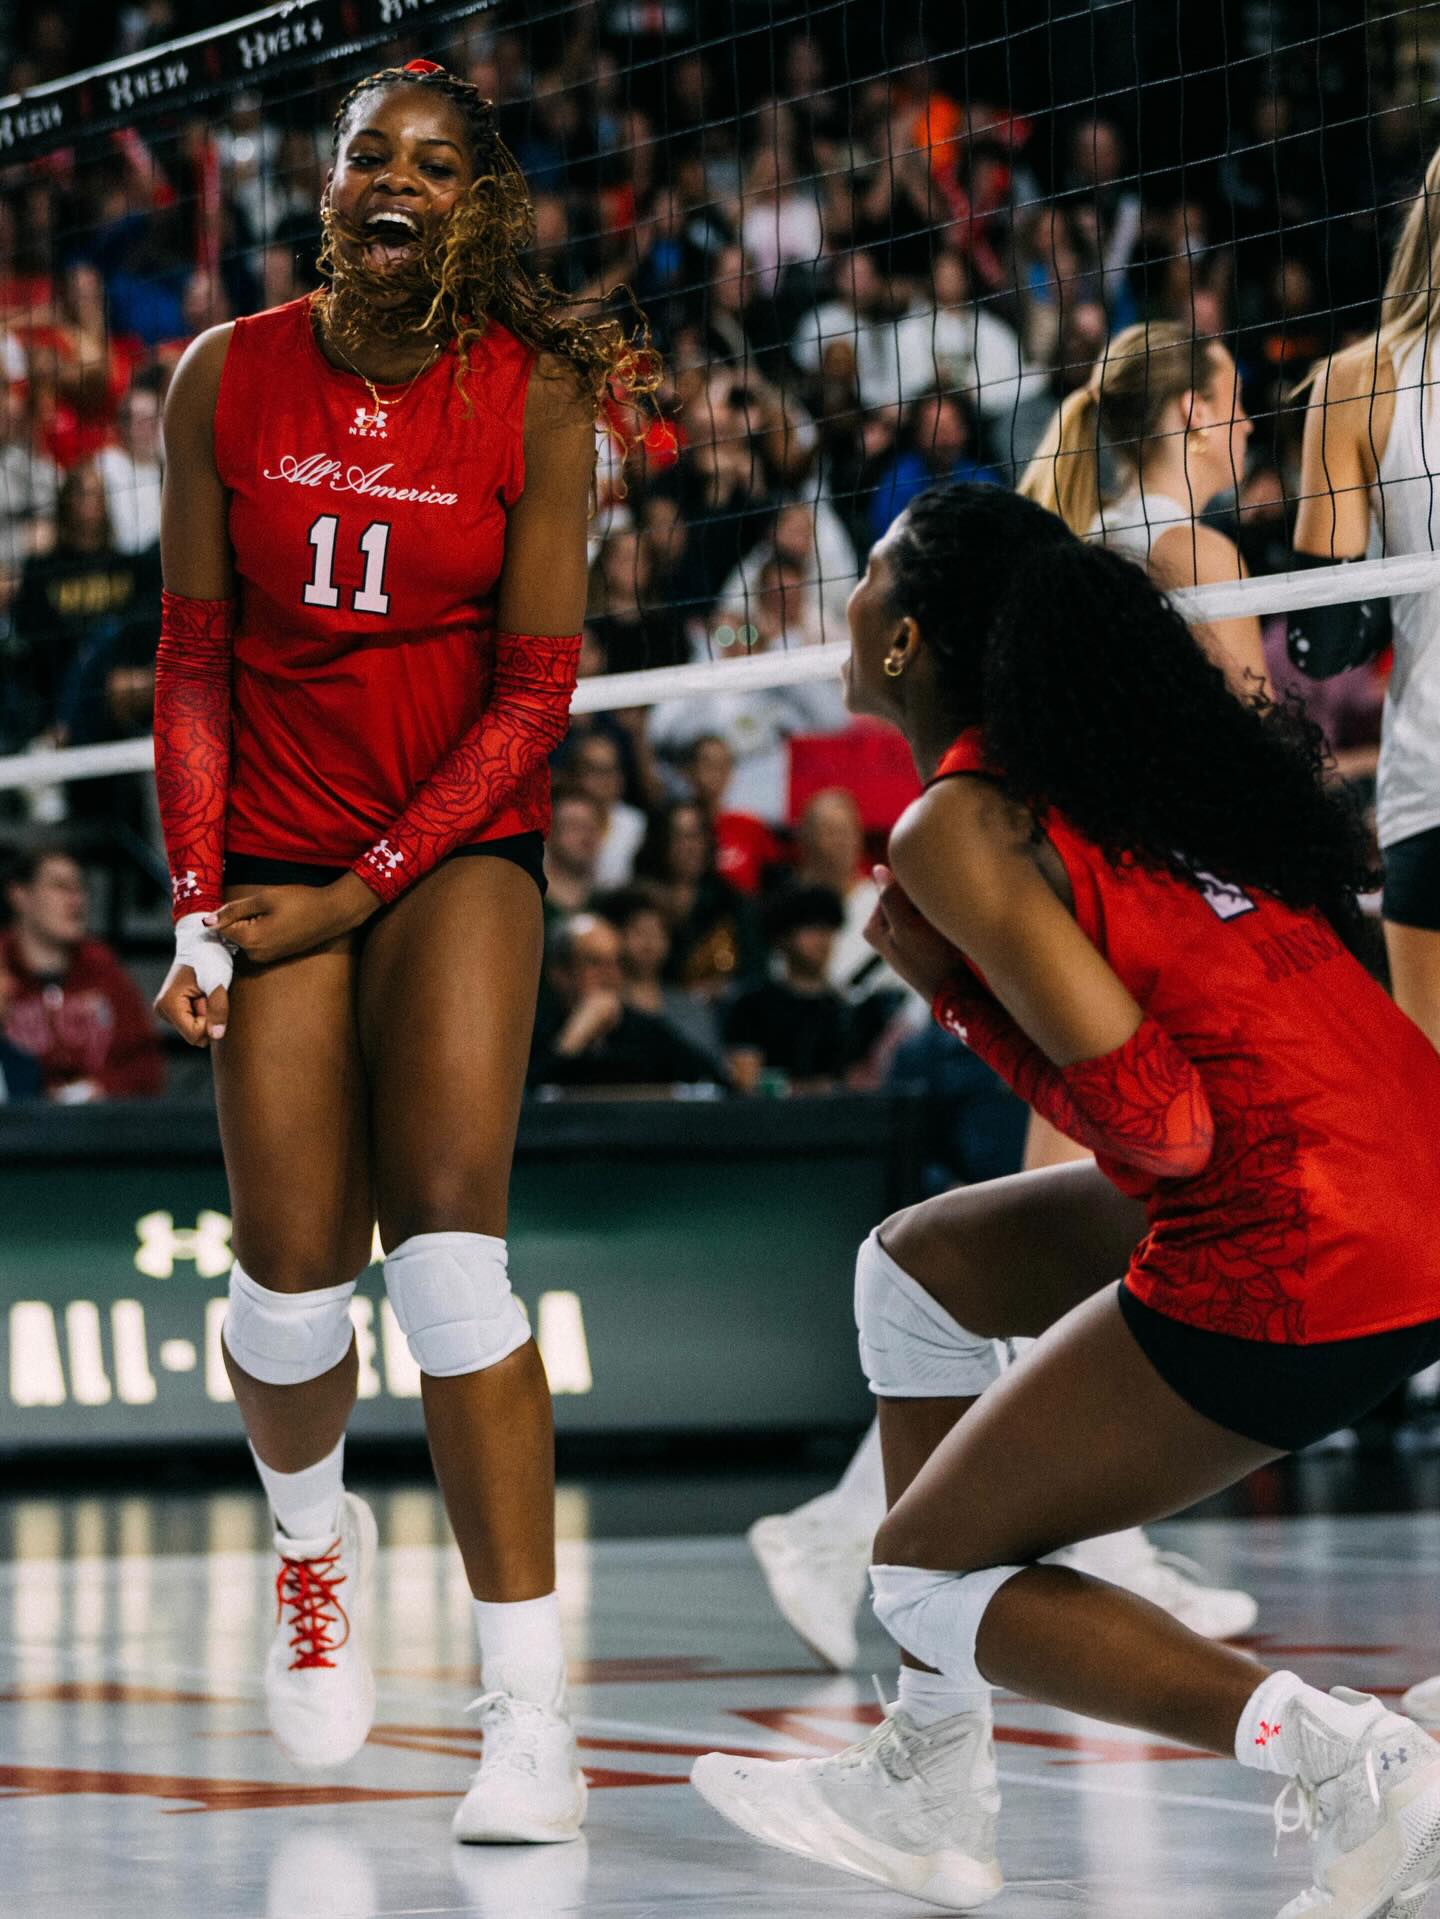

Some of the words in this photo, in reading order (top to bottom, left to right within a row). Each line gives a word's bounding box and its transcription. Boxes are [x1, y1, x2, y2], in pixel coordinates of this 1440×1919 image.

[263, 452, 342, 487] All
[329, 463, 458, 505] America
[302, 512, 392, 616] 11
